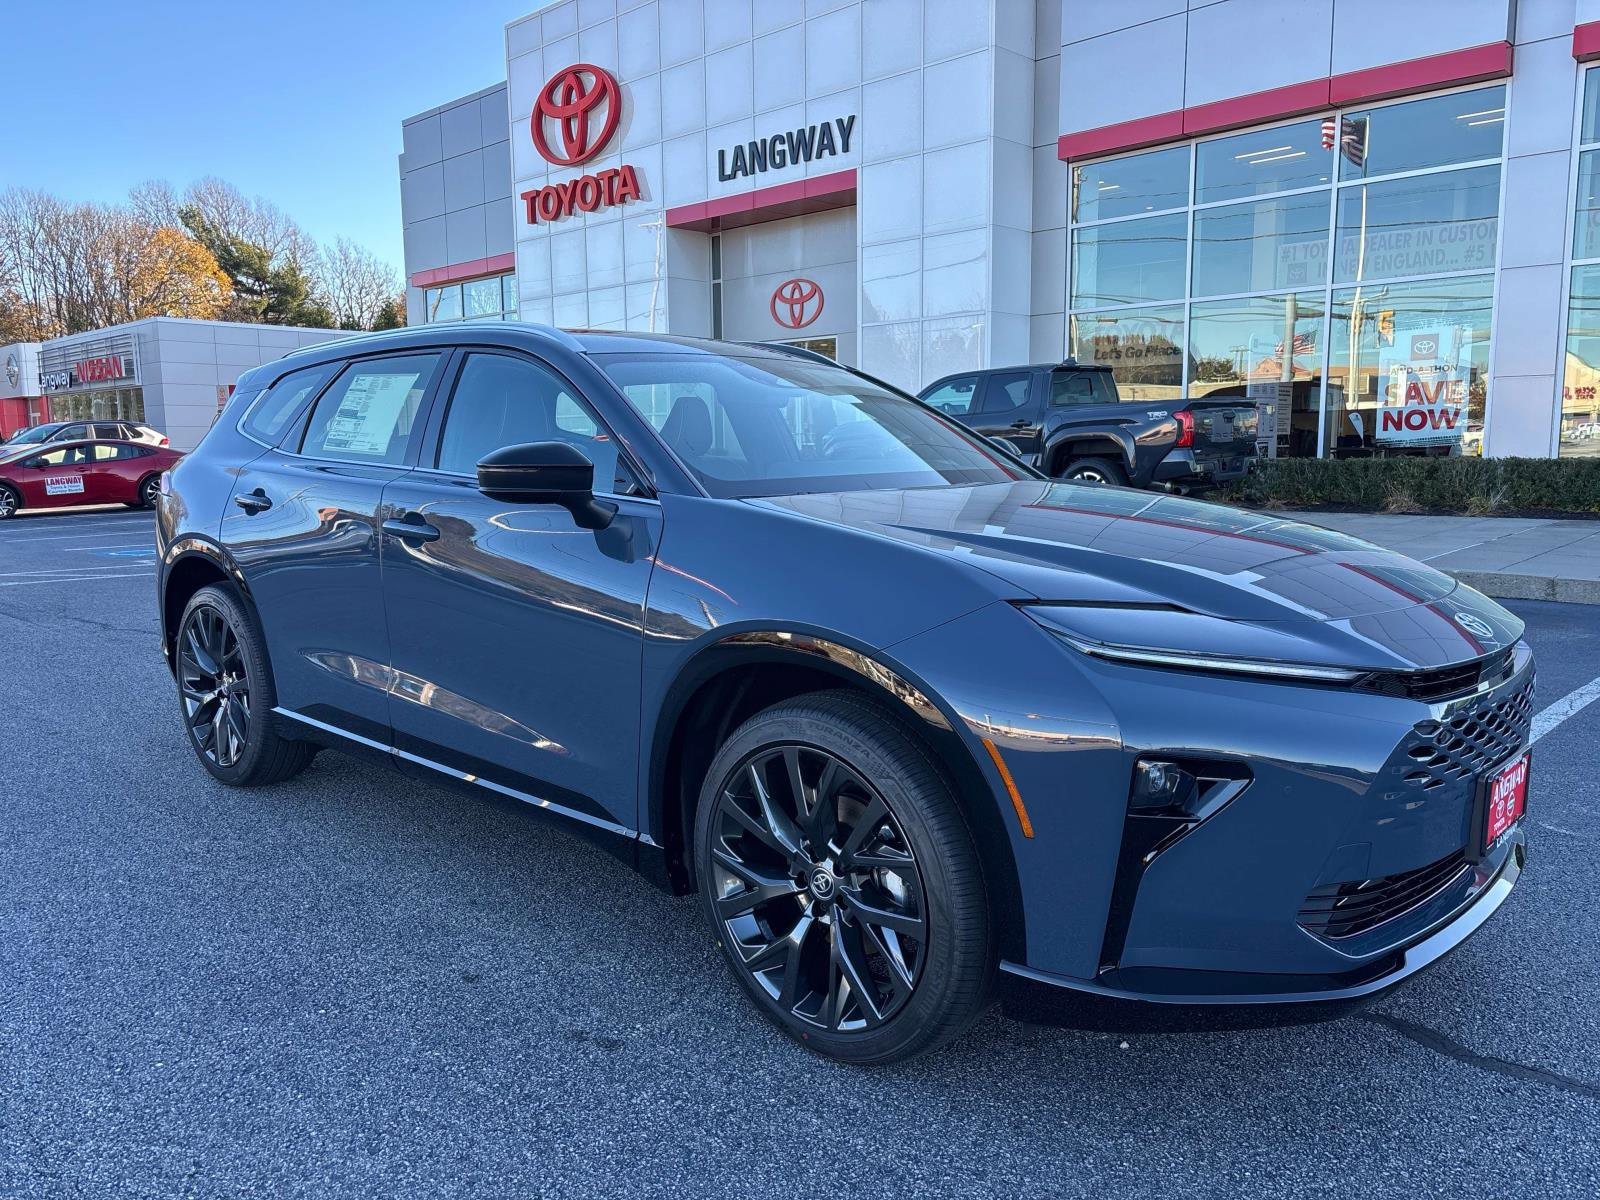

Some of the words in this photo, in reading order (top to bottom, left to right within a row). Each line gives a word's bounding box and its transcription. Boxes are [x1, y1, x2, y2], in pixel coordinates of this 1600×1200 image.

[718, 115, 856, 182] LANGWAY
[521, 164, 640, 225] TOYOTA
[1303, 237, 1355, 260] TOYTA
[1416, 230, 1435, 248] IN
[1125, 346, 1143, 359] Go
[76, 355, 123, 383] NISSAN
[1383, 379, 1463, 407] SAVE
[1147, 410, 1168, 419] TRD
[1382, 408, 1461, 432] NOW
[46, 476, 82, 486] LANGWAY
